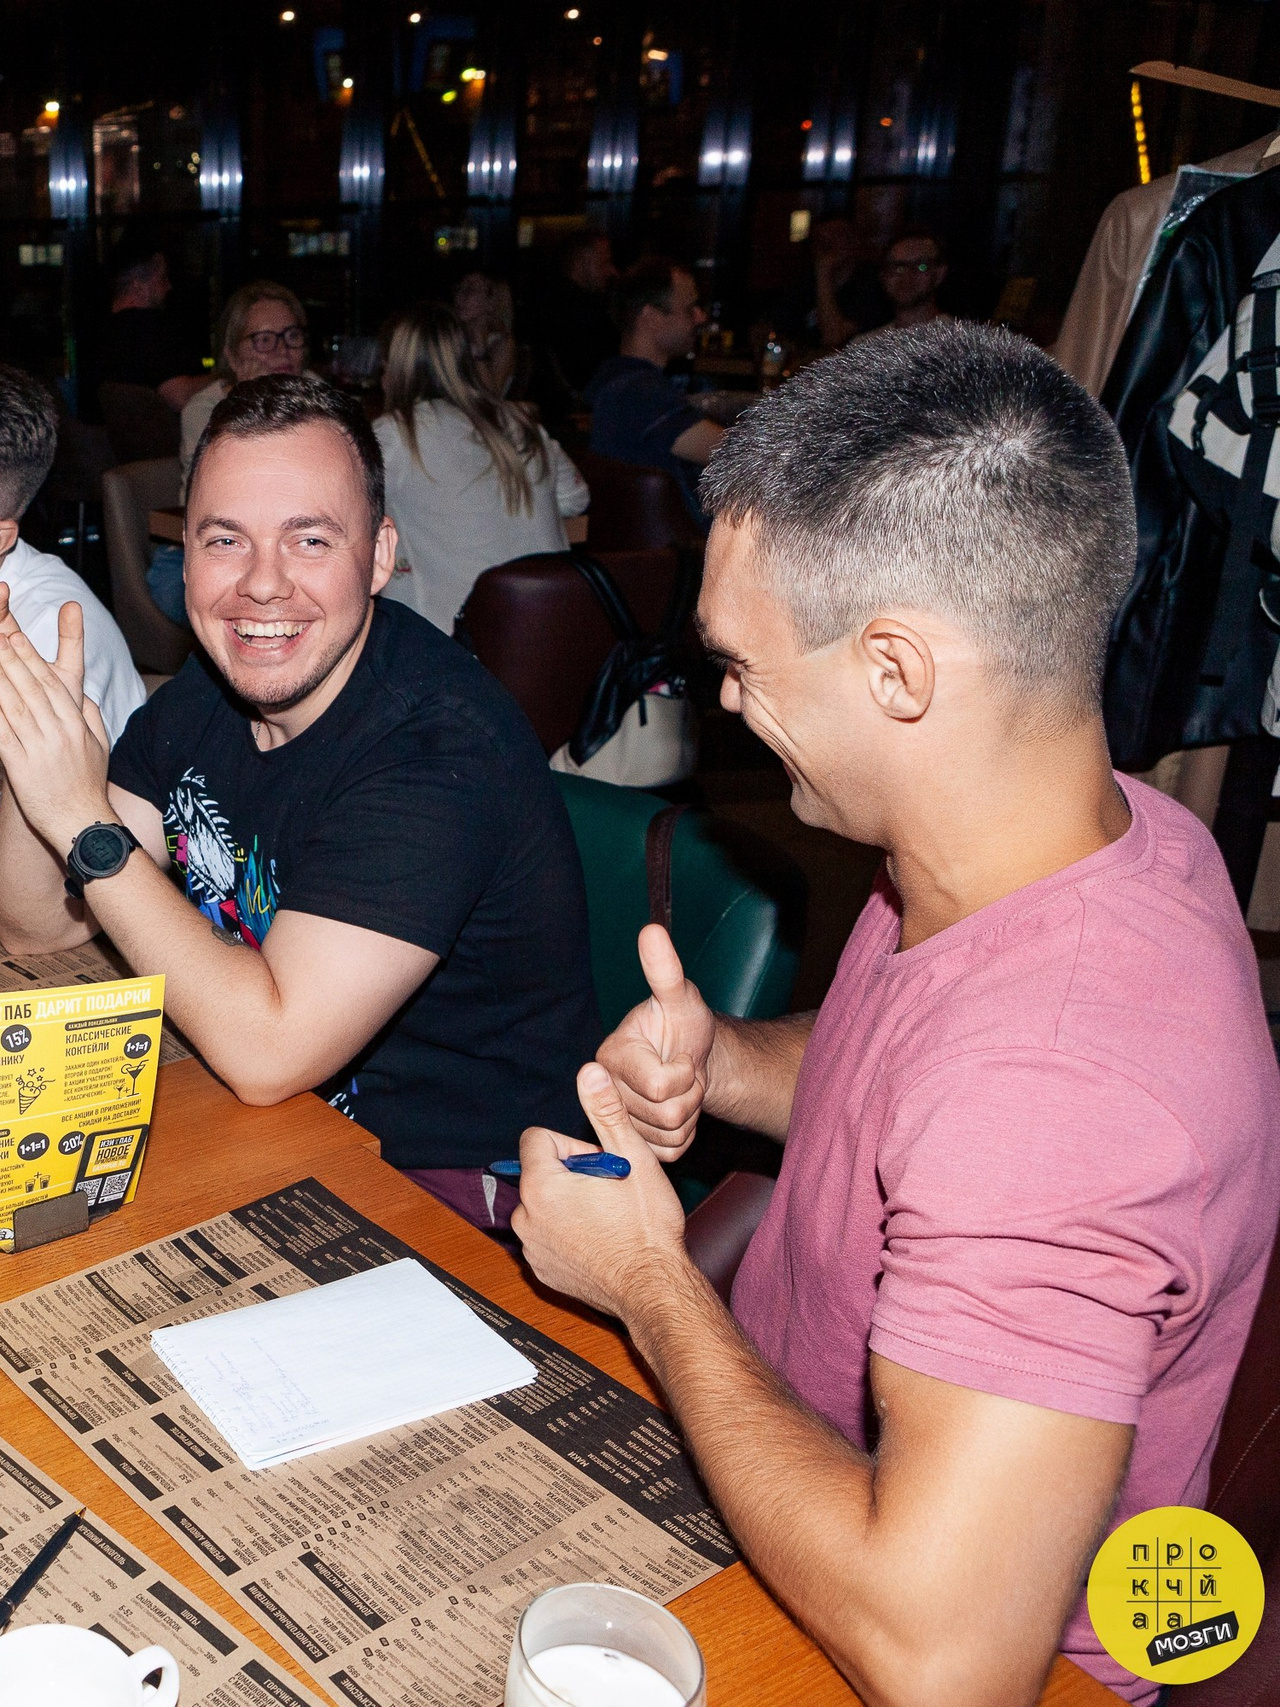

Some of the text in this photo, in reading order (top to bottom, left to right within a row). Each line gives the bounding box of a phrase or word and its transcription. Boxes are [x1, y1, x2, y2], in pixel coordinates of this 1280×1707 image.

[4, 1003, 32, 1020] ПАБ
[35, 988, 151, 1018] ДАРИТ ПОДАРКИ
[6, 1029, 29, 1048] 15%
[65, 1025, 131, 1043] КЛАССИЧЕСКИЕ
[65, 1040, 109, 1056] КОКТЕЙЛИ
[127, 1041, 149, 1053] 1+1=1
[64, 1062, 85, 1070] ЗАКАЖИ
[64, 1071, 83, 1079] ВТОРОЙ
[88, 1065, 112, 1074] ПОДАРОК!
[68, 1078, 85, 1086] АКЦИИ
[86, 1072, 113, 1082] УЧАСТВУЮТ
[74, 1083, 98, 1092] КОКТЕЙЛИ
[99, 1077, 125, 1087] КАТЕГОРИИ
[61, 1114, 72, 1122] ВСЕ
[74, 1109, 93, 1119] АКЦИИ
[100, 1098, 141, 1113] ПРИЛОЖЕНИИ!
[78, 1116, 101, 1127] СКИДКИ
[112, 1107, 140, 1119] ДОСТАВКУ
[20, 1139, 45, 1155] 1+1=1
[100, 1135, 132, 1147] ИЗИ ПАБ
[96, 1144, 130, 1160] НОВОЕ
[566, 1451, 590, 1466] МАКИ
[29, 1484, 56, 1505] КОКТЕЙЛИ
[660, 1519, 698, 1544] ГУНКАНЫ
[17, 1543, 35, 1558] ВИСКИ
[76, 1524, 127, 1565] КРЕПКИЙ АЛКОГОЛЬ
[395, 1543, 449, 1589] КРАСНЫЙ ГРЕЙПФРУТ
[662, 1558, 696, 1578] РОМ-КОЛА
[666, 1545, 709, 1571] ДЖИН-ТОНИК
[328, 1562, 348, 1578] МЯТОЙ
[394, 1563, 436, 1597] ТЫКВА-КОРИЦА
[617, 1564, 667, 1596] ГОЛУБАЯ ЛАГУНА
[643, 1562, 683, 1586] ВИСКИ-КОЛА
[312, 1561, 373, 1616] ДОМАШНИЕ НАСТОЙКИ
[347, 1580, 372, 1601] МАЛИНЕ
[360, 1572, 408, 1614] ГРЕЧКА-АПЕЛЬСИН
[380, 1570, 422, 1606] ЯГОДНЫЙ МИКС
[117, 1604, 134, 1616] Б-52
[134, 1593, 182, 1631] СКОЛЬЗКИЙ СОСОК
[368, 1599, 379, 1607] НА
[179, 1609, 201, 1626] ШОТЫ
[246, 1585, 323, 1657] БЕЗАЛКОГОЛЬНЫЕ КОКТЕЙЛИ
[375, 1606, 395, 1622] ДЖИН
[319, 1616, 353, 1645] МИЛК ШЕЙК
[233, 1671, 276, 1705] РОМАШКОВЫЙ
[262, 1679, 293, 1703] ГОРЯЧИЕ
